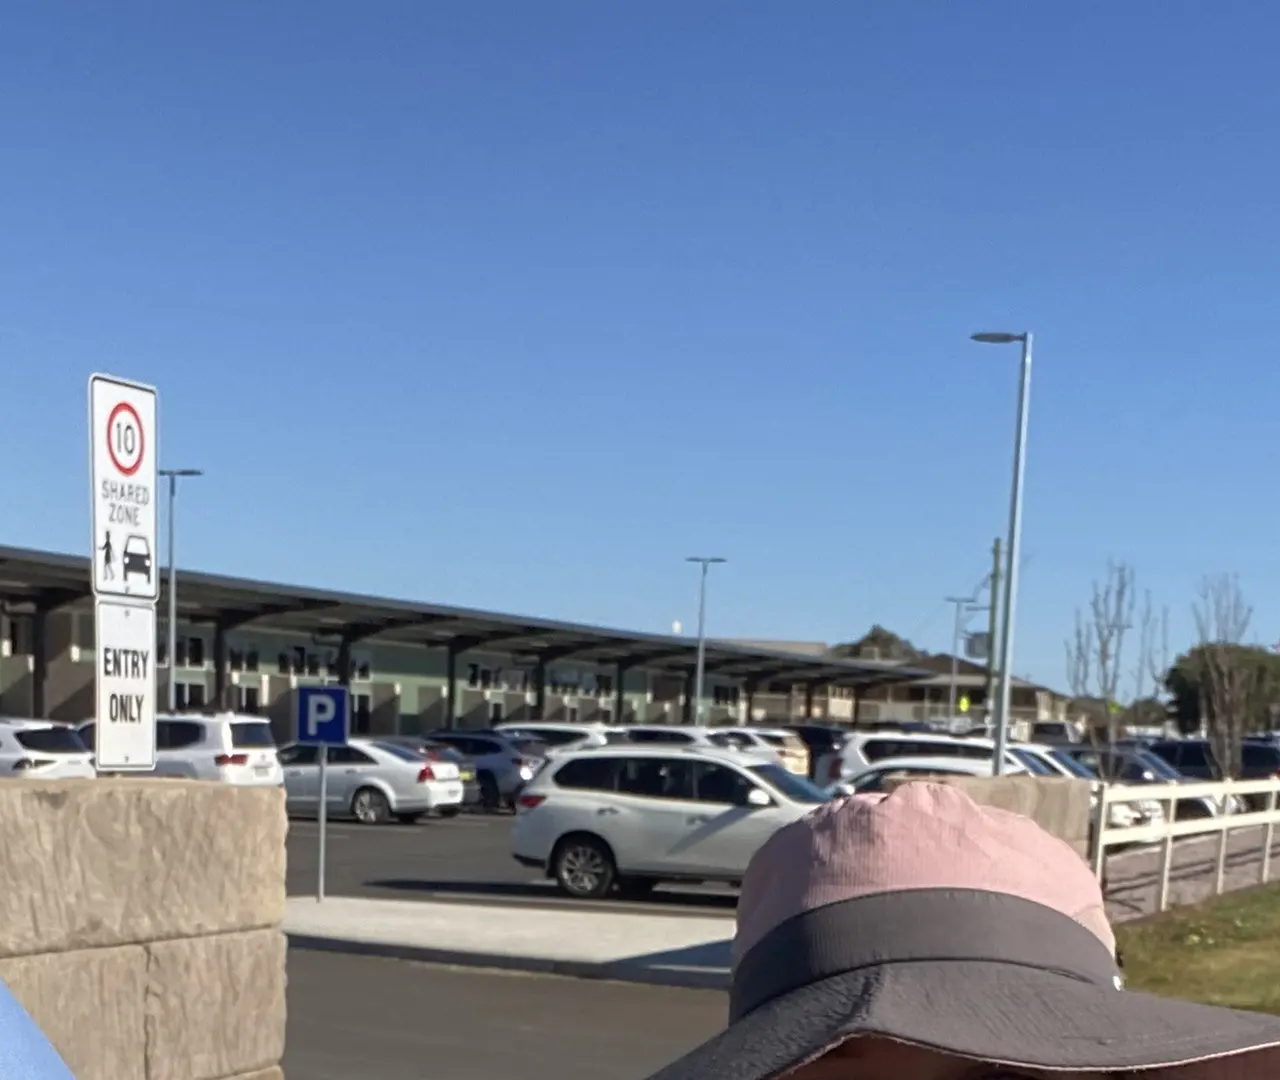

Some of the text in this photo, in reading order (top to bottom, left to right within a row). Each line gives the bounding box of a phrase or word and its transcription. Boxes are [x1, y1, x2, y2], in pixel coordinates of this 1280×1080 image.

[116, 422, 136, 456] 10
[101, 479, 150, 506] SHARED
[109, 502, 141, 527] ZONE
[103, 647, 149, 680] ENTRY
[109, 693, 145, 724] ONLY
[307, 693, 336, 737] P
